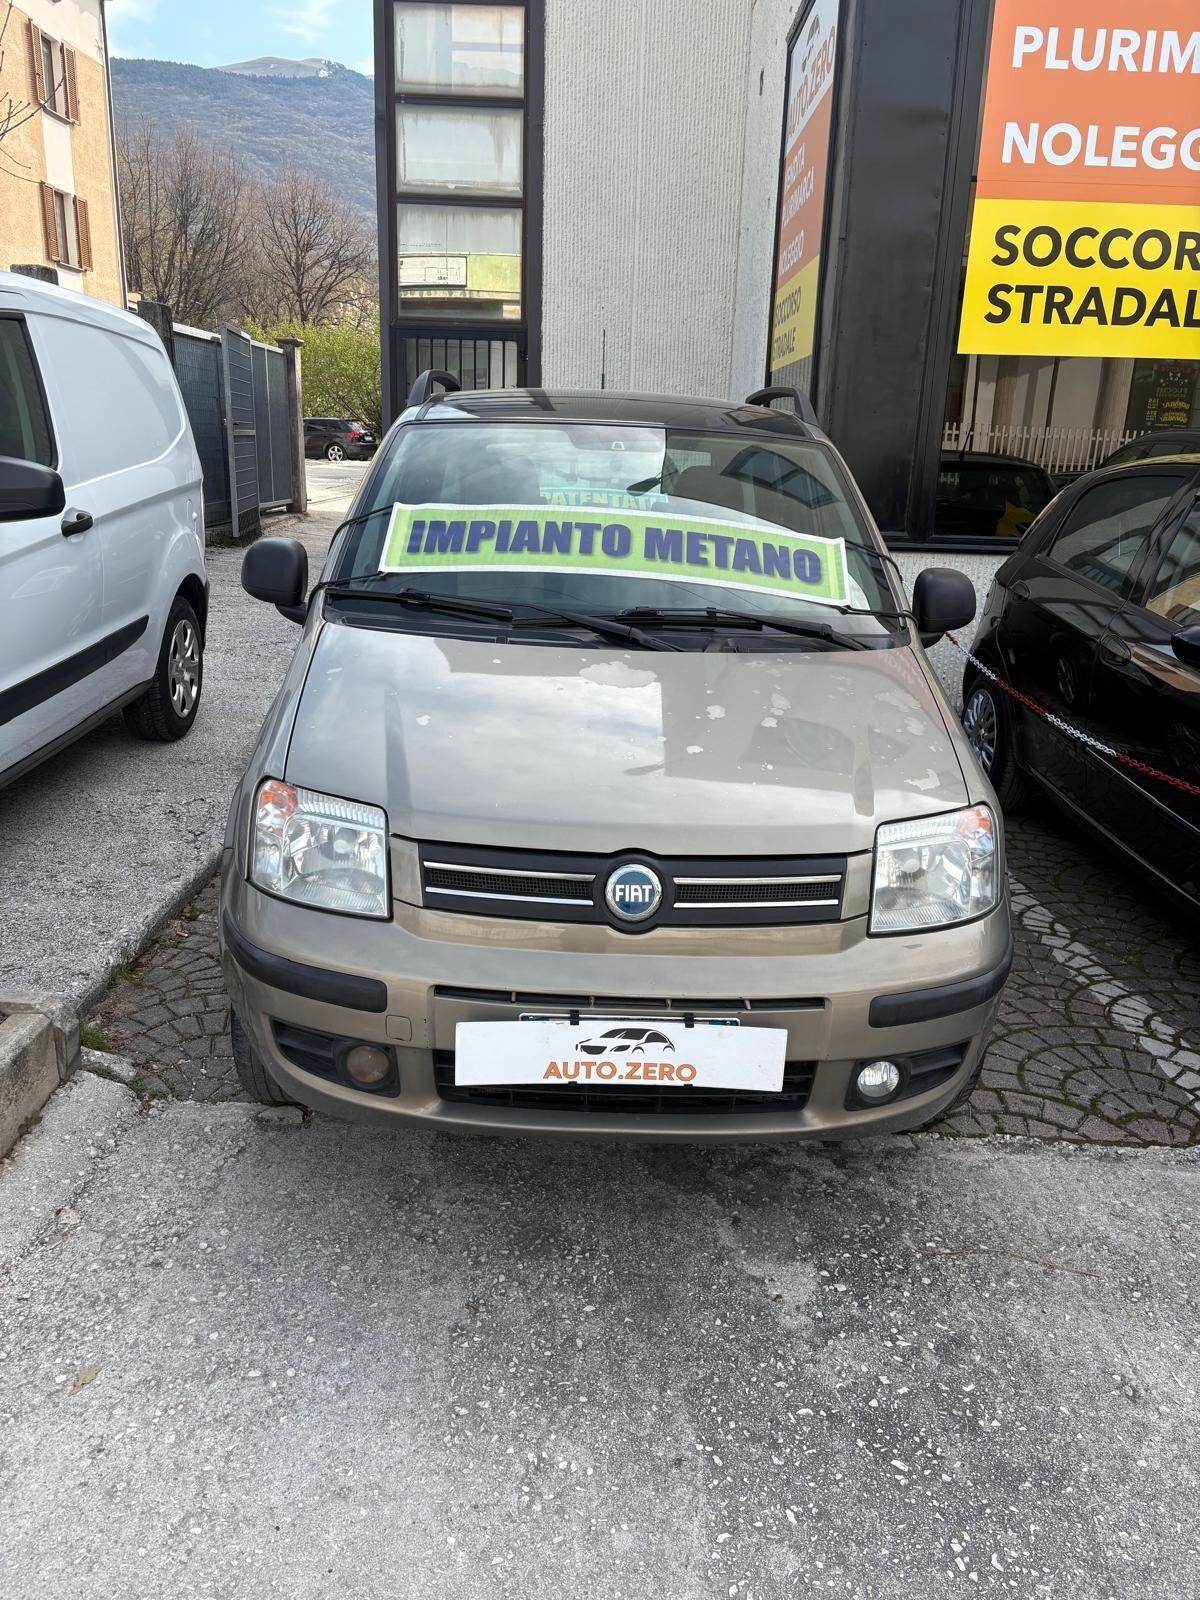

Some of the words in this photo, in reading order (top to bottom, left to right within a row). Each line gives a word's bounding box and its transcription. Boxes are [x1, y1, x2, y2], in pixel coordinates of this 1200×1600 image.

[1011, 25, 1200, 74] PLURIM
[1002, 121, 1200, 171] NOLEGG
[991, 224, 1200, 271] SOCCOR
[984, 283, 1200, 328] STRADAL
[407, 520, 631, 557] IMPIANTO
[643, 527, 821, 583] METANO
[615, 884, 652, 902] FIAT
[543, 1061, 697, 1082] AUTO.ZERO
